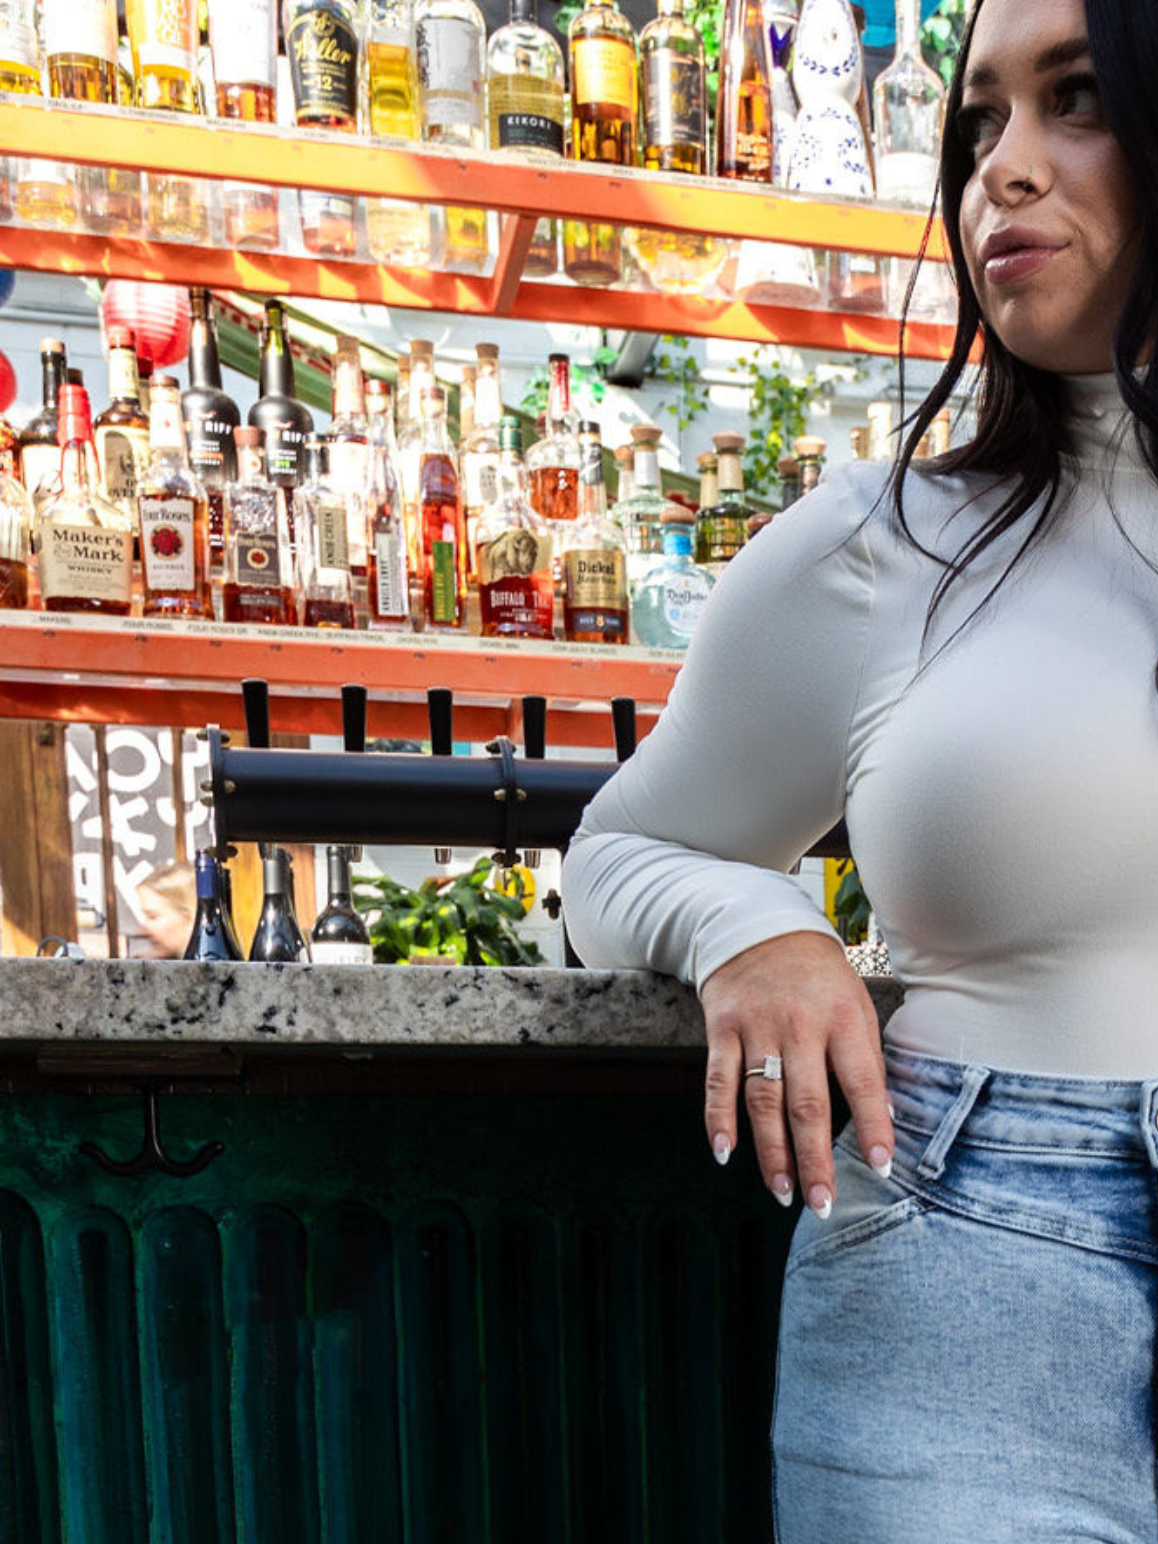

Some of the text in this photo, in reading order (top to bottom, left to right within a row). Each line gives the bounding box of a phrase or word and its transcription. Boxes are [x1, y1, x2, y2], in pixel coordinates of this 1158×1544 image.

[506, 115, 552, 130] KIKORI
[53, 528, 124, 548] Maker's
[74, 546, 124, 563] Mark
[68, 564, 113, 575] WHISKY
[578, 560, 615, 575] Dickel
